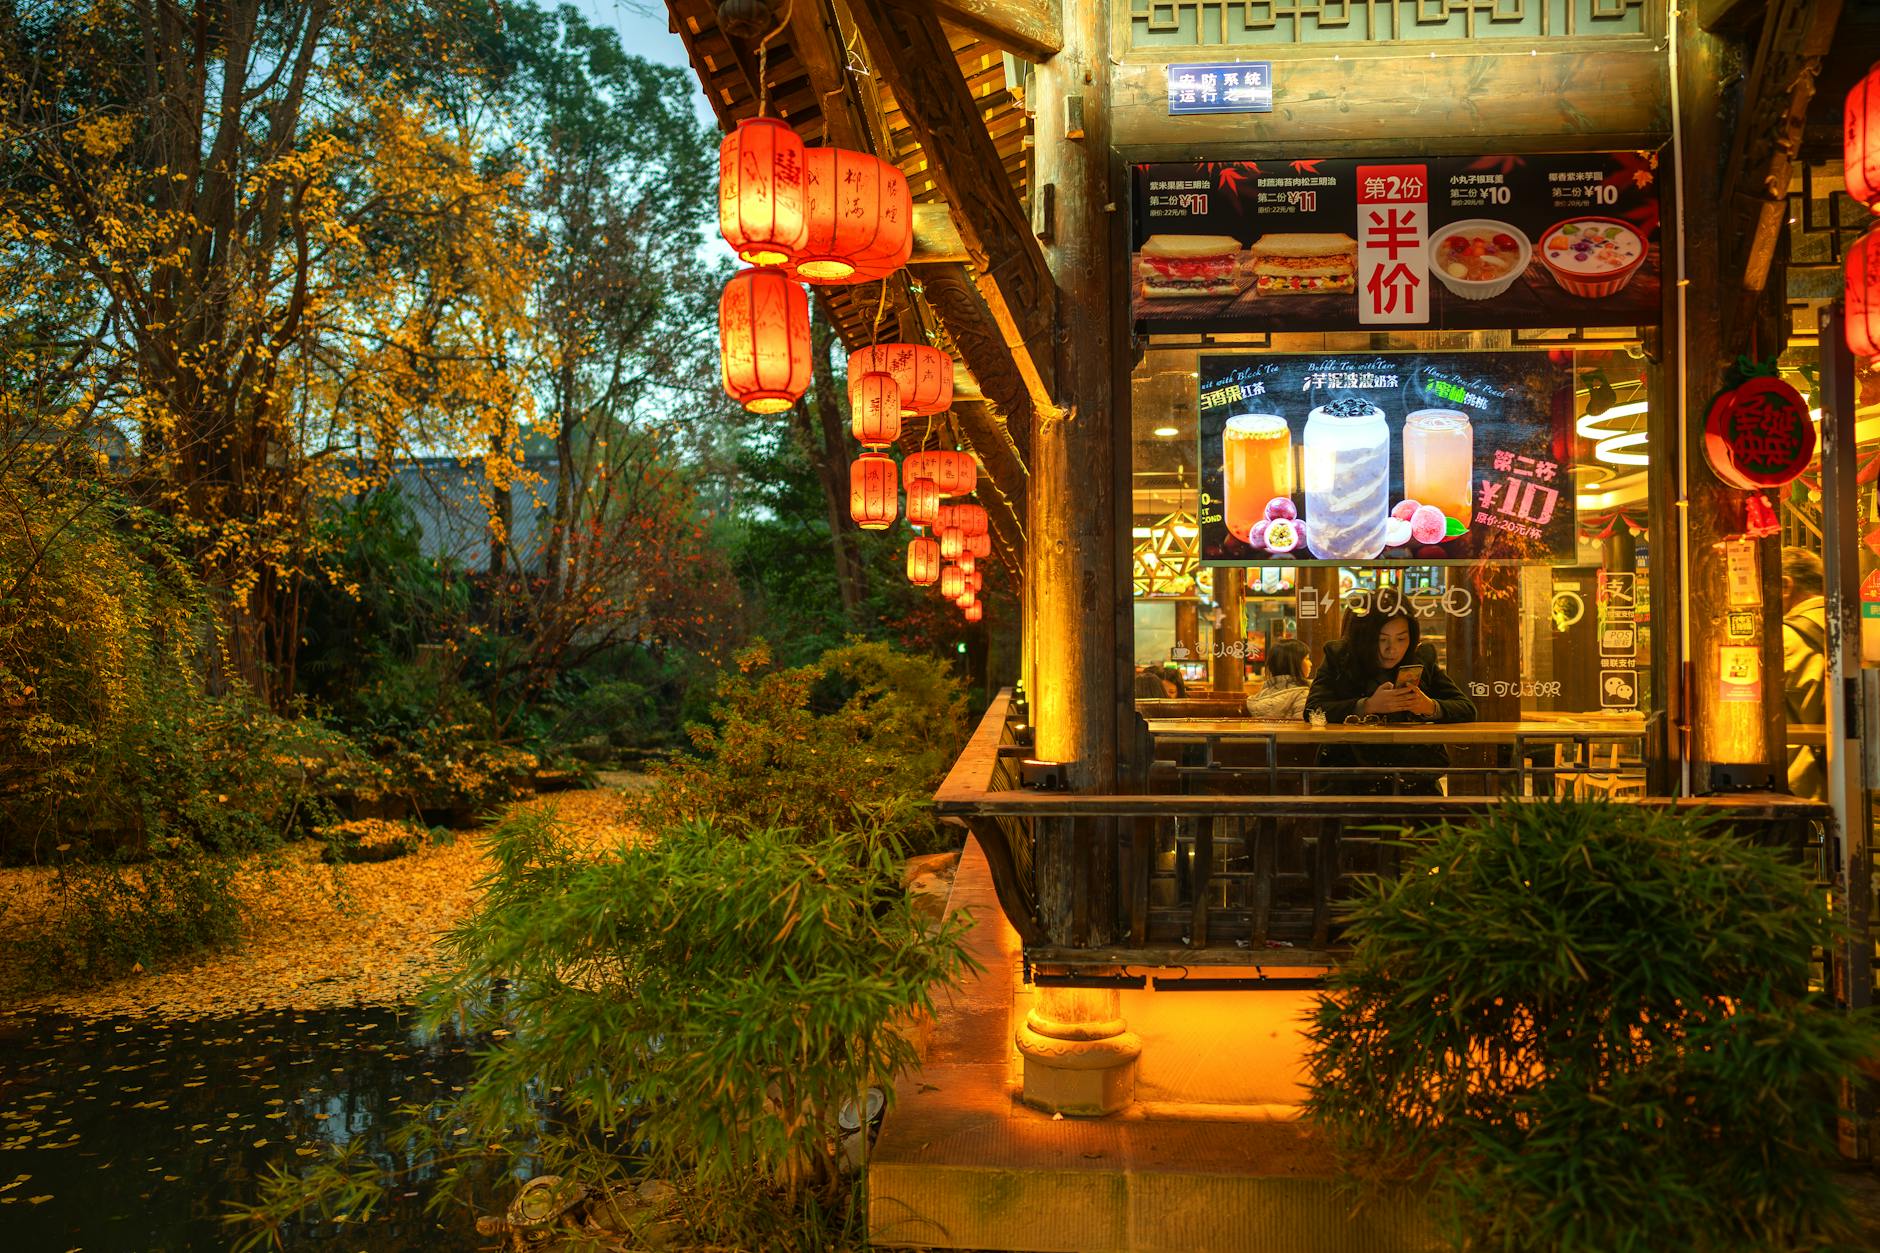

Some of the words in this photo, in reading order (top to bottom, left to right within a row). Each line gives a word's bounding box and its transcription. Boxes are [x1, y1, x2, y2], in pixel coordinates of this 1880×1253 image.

[1150, 180, 1211, 190] 紫米果酱三明治
[1257, 176, 1336, 187] 时蔬海苔肉松三明治
[1364, 175, 1423, 199] 第2份
[1150, 195, 1178, 206] 第二份
[1179, 193, 1208, 215] ¥11
[1257, 192, 1287, 203] 第二份
[1287, 190, 1317, 212] ¥11
[1450, 188, 1478, 198] 第二份
[1480, 186, 1511, 205] ¥10
[1552, 187, 1582, 198] 第二份
[1584, 184, 1618, 205] ¥10
[1366, 209, 1421, 314] 半价
[1264, 363, 1280, 374] Tea
[1307, 360, 1336, 371] Bubble
[1339, 361, 1355, 370] Tea
[1493, 449, 1558, 481] 第二杯
[1478, 476, 1559, 525] ¥10
[1475, 511, 1543, 540] 原价:20元/杯
[1345, 584, 1473, 617] 可以充电
[1611, 631, 1631, 639] POS
[1600, 658, 1636, 668] 银联支付
[1493, 680, 1561, 697] 可以拍照
